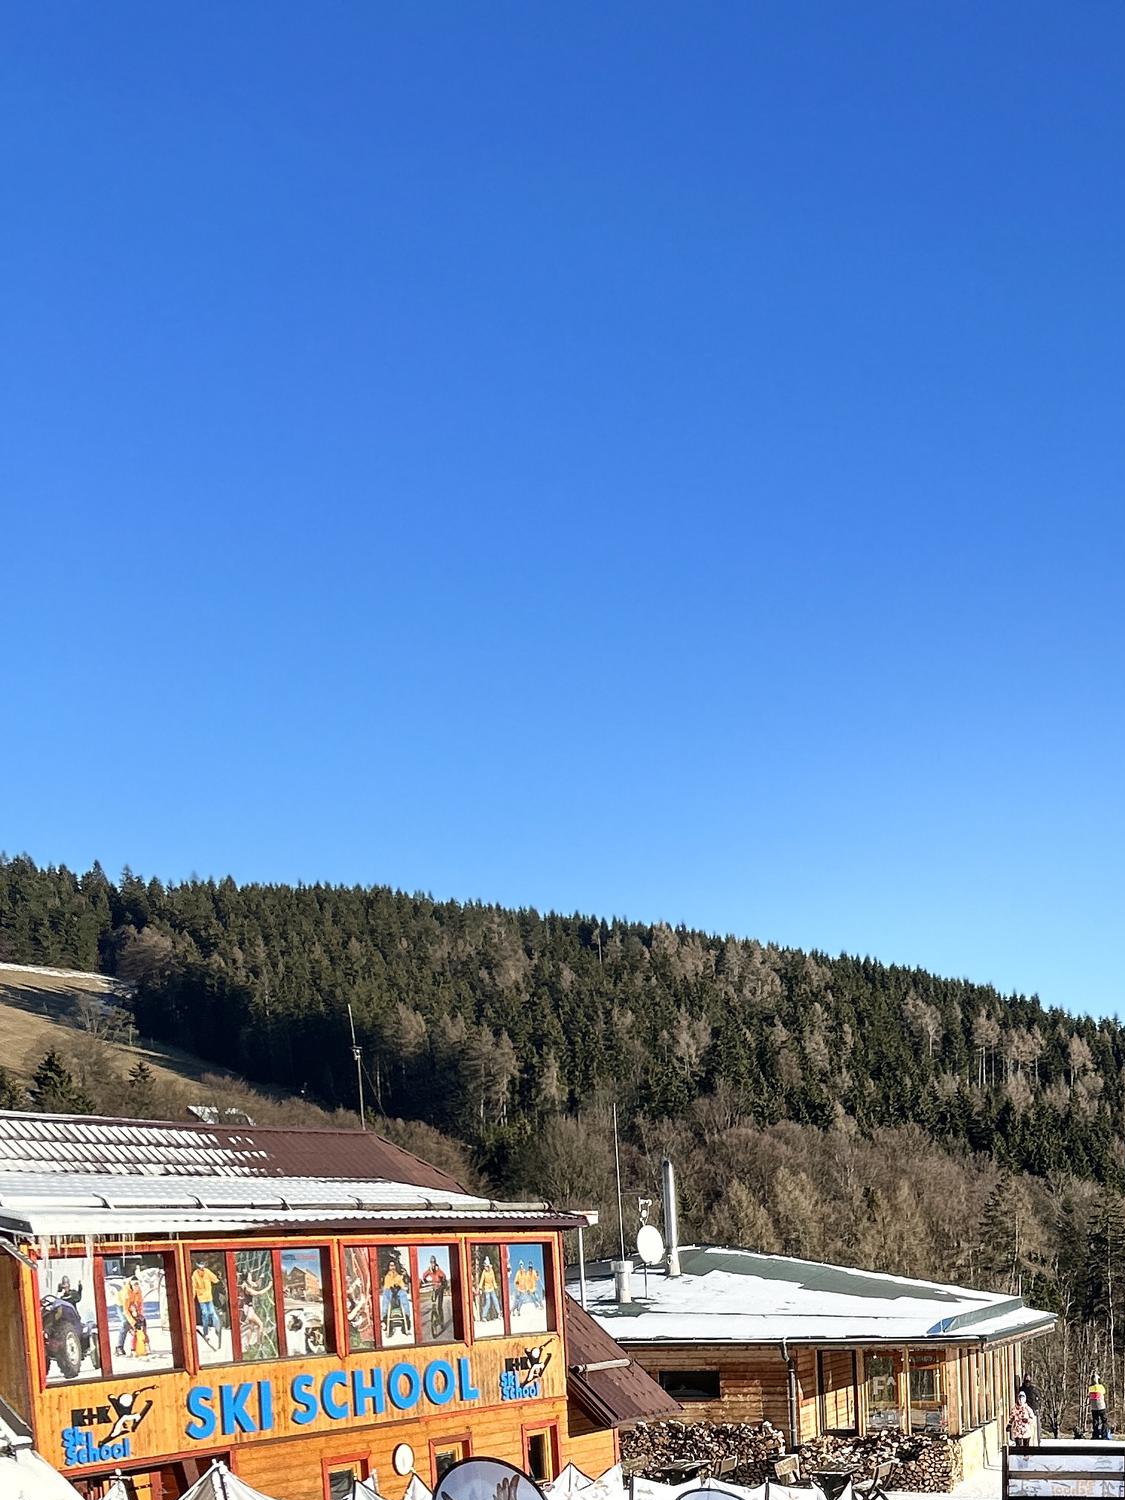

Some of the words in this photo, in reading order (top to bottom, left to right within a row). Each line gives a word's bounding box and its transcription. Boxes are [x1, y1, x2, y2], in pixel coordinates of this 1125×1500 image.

[185, 1380, 274, 1440] SKI
[291, 1357, 480, 1425] SCHOOL
[501, 1381, 541, 1401] School
[71, 1405, 113, 1428] K+K
[64, 1438, 131, 1467] School
